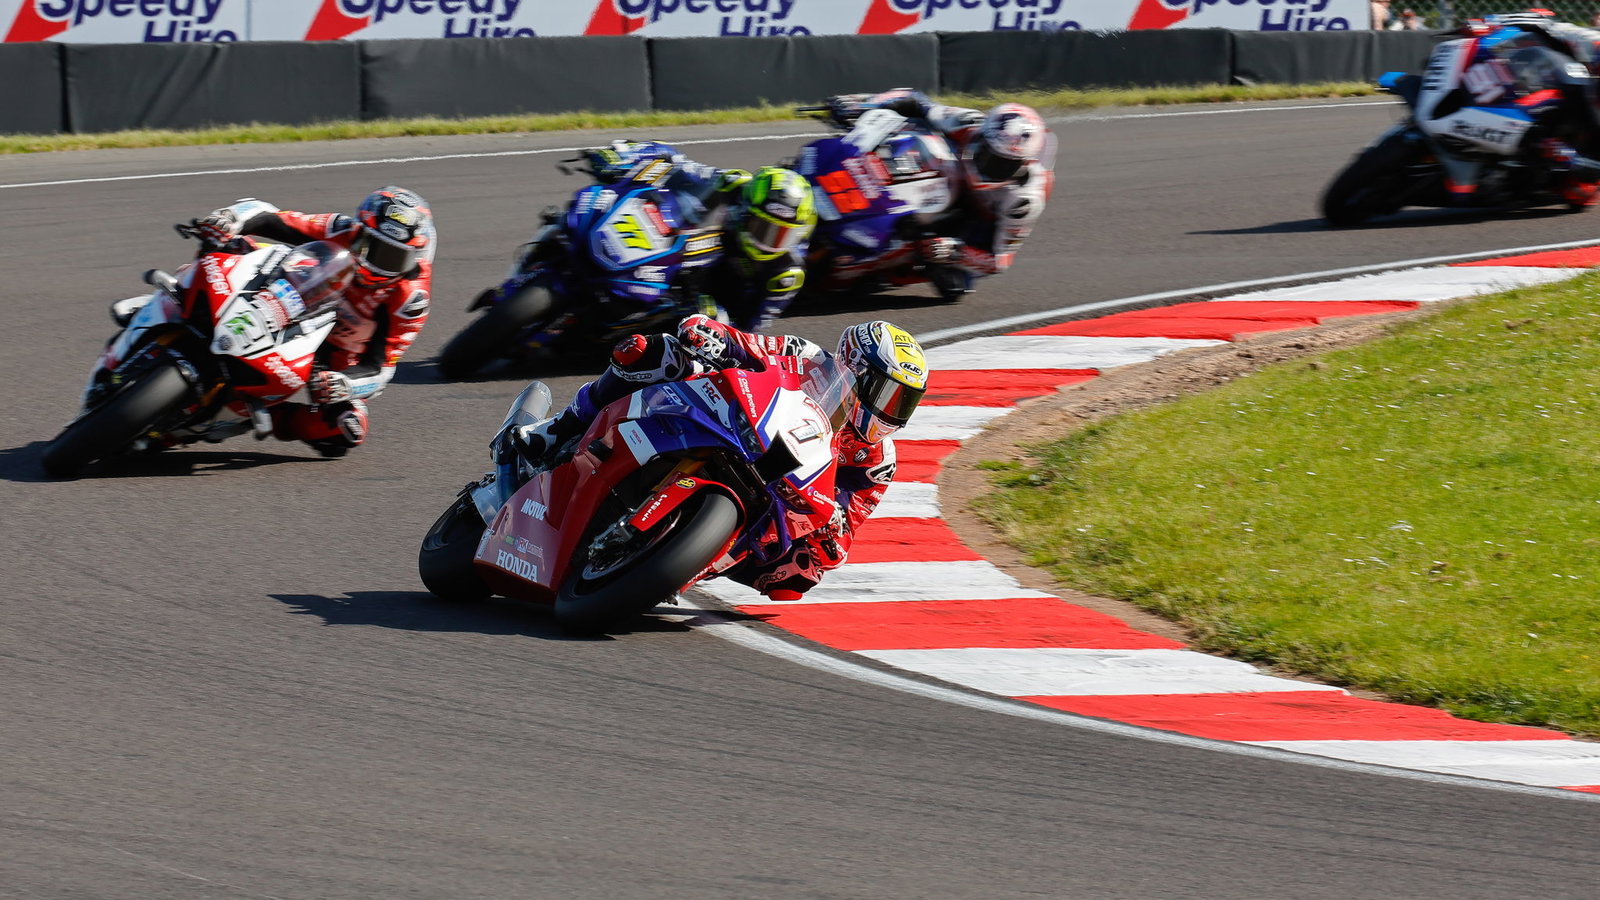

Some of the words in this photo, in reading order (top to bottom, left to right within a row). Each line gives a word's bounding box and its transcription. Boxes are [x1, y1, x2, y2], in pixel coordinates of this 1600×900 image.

[903, 363, 921, 374] HJC
[701, 382, 720, 404] HRC
[787, 418, 822, 444] 1
[521, 498, 548, 520] MOTUL
[495, 549, 538, 583] HONDA
